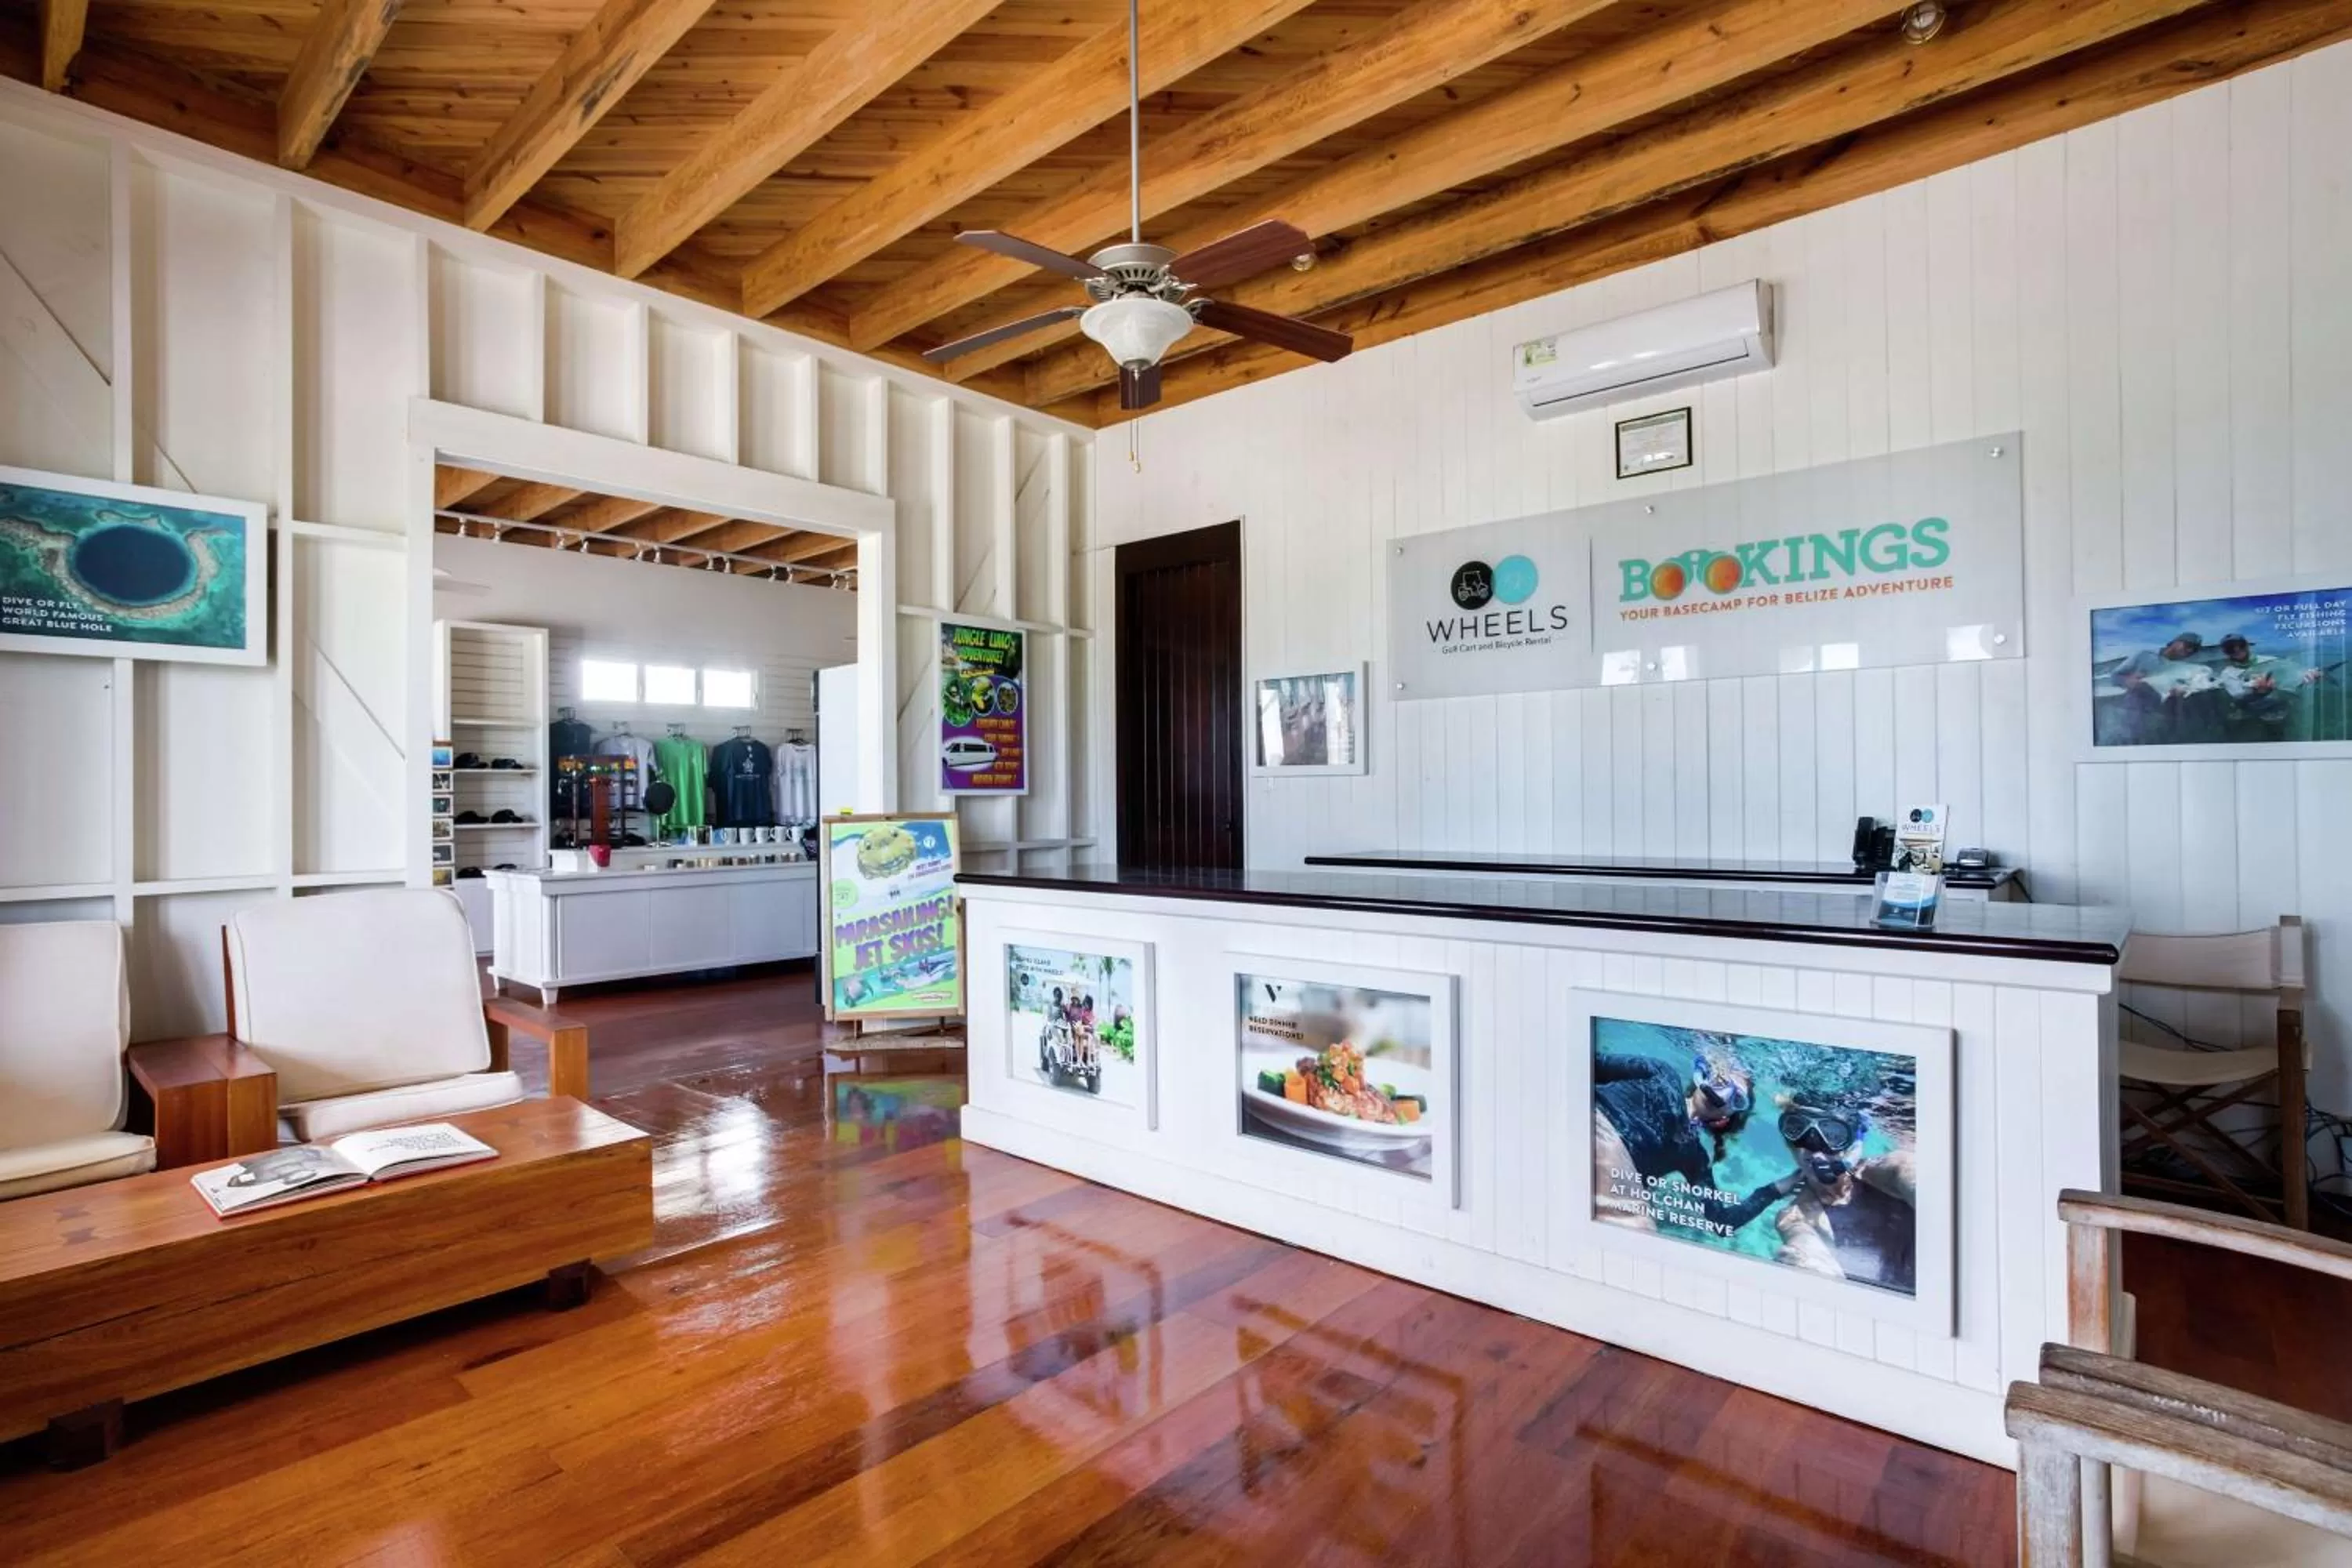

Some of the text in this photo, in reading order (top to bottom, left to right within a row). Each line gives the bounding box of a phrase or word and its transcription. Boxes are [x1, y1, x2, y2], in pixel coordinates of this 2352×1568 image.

[1618, 517, 1951, 601] BOOKINGS
[2, 597, 32, 606] DIVE
[1620, 576, 1955, 621] YOUR BASECAMP FOR BELIZE ADVENTURE
[2324, 600, 2347, 609] DAY
[2, 606, 103, 621] WORLD FAMOUS
[2, 617, 113, 632] GREAT BLUE HOLE
[1427, 605, 1568, 643] WHEELS
[2274, 619, 2347, 630] EXCURSIONS
[2299, 609, 2347, 619] FISHING
[953, 627, 1012, 650] JUNGLE LIMO
[1442, 645, 1457, 654] Golf
[1460, 644, 1477, 652] Cart
[1495, 640, 1523, 649] Bicycle
[1526, 636, 1552, 645] Rental
[835, 895, 954, 948] PARASAILING!
[853, 922, 945, 971] JET SKIS!
[1610, 1168, 1741, 1206] DIVE OR SNORKEL
[1610, 1184, 1705, 1214] AT HOL CHAN
[1610, 1201, 1734, 1237] MARINE RESERVE
